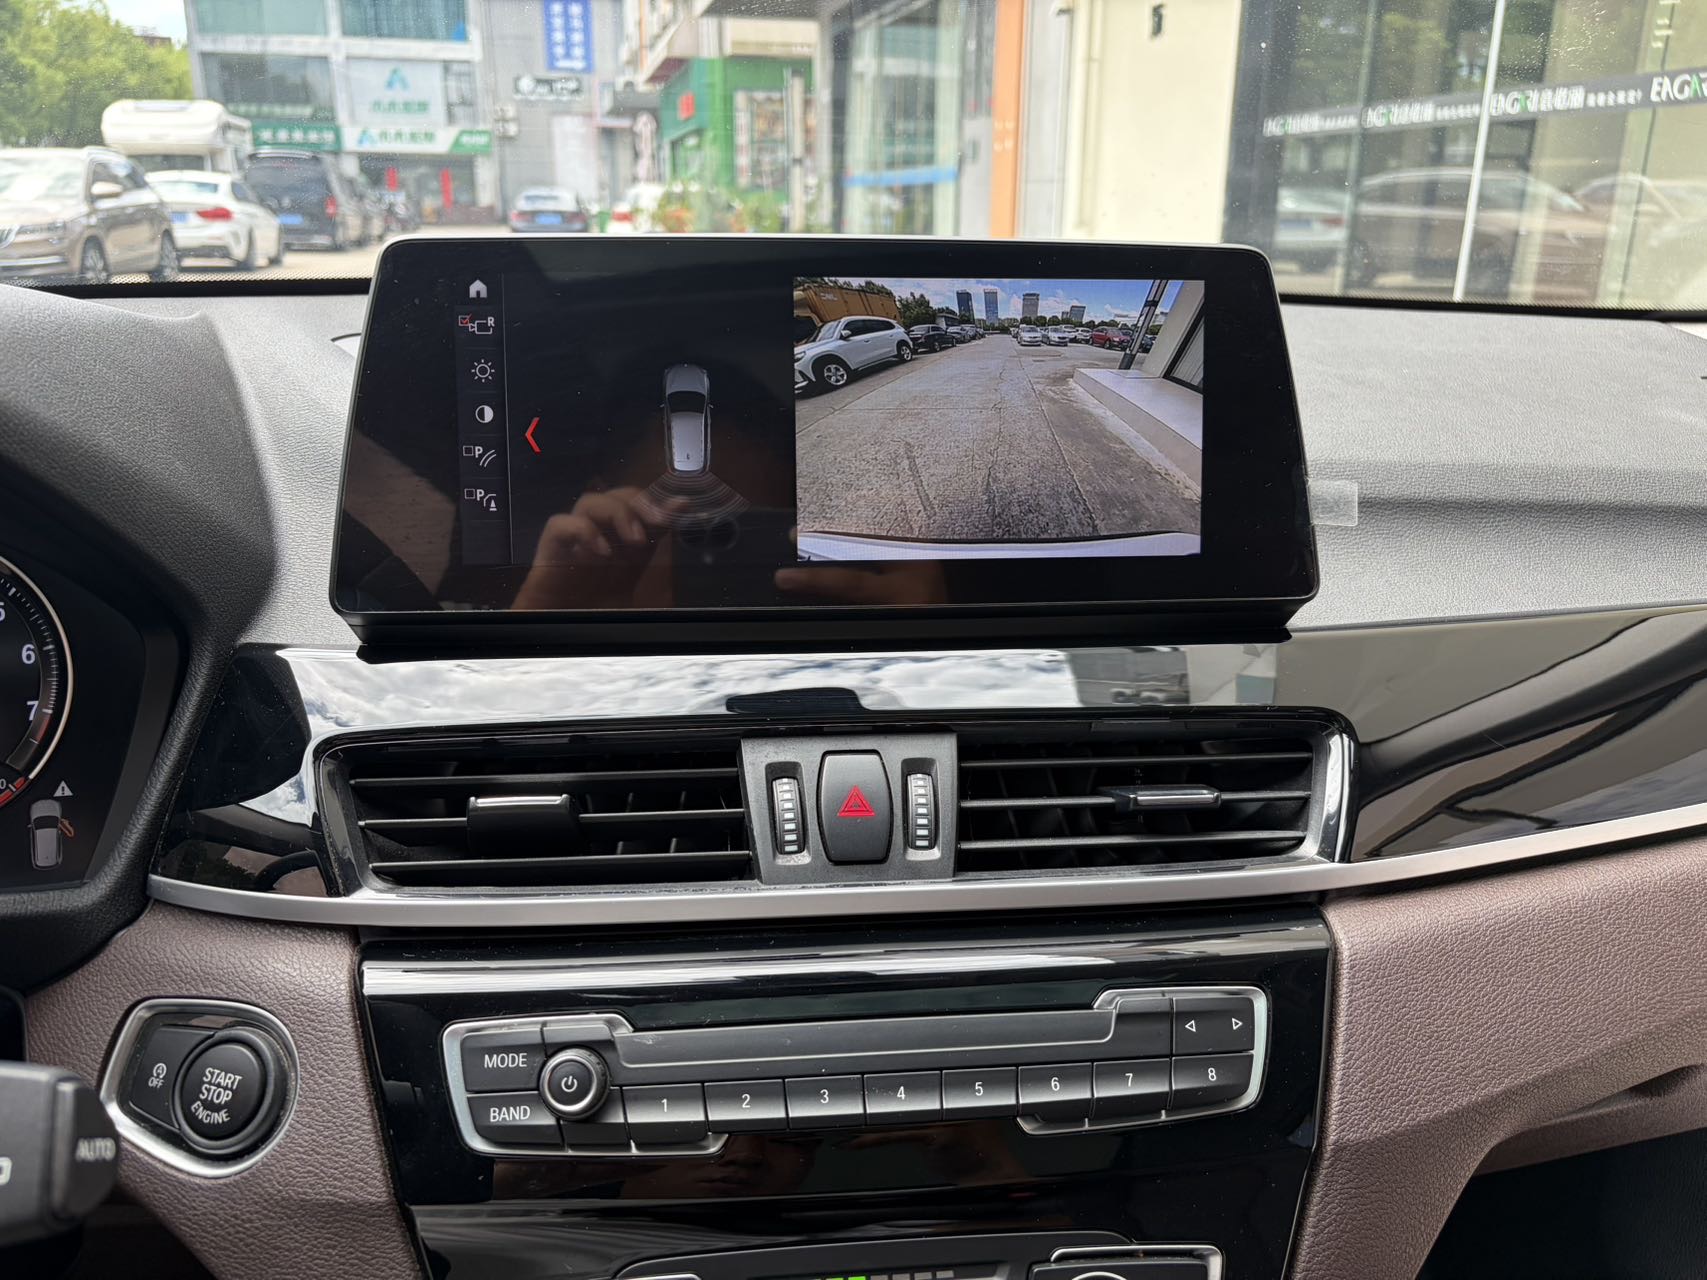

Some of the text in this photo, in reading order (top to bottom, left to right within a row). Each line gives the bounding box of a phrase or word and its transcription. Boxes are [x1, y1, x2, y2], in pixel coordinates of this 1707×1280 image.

[487, 316, 495, 327] R
[474, 445, 483, 458] P
[476, 488, 485, 502] P
[21, 643, 36, 665] 6
[26, 700, 39, 721] 7
[484, 1052, 528, 1069] MODE
[148, 1077, 164, 1088] OFF
[202, 1067, 243, 1090] START
[1124, 1072, 1134, 1088] 7
[1207, 1067, 1217, 1082] 8
[974, 1081, 984, 1097] 5
[1050, 1076, 1061, 1092] 6
[199, 1084, 233, 1105] STOP
[819, 1088, 830, 1104] 3
[896, 1085, 906, 1100] 4
[661, 1098, 668, 1113] 1
[741, 1093, 751, 1109] 2
[190, 1100, 231, 1125] ENGINE
[489, 1105, 531, 1122] BAND
[75, 1137, 117, 1162] AUTO
